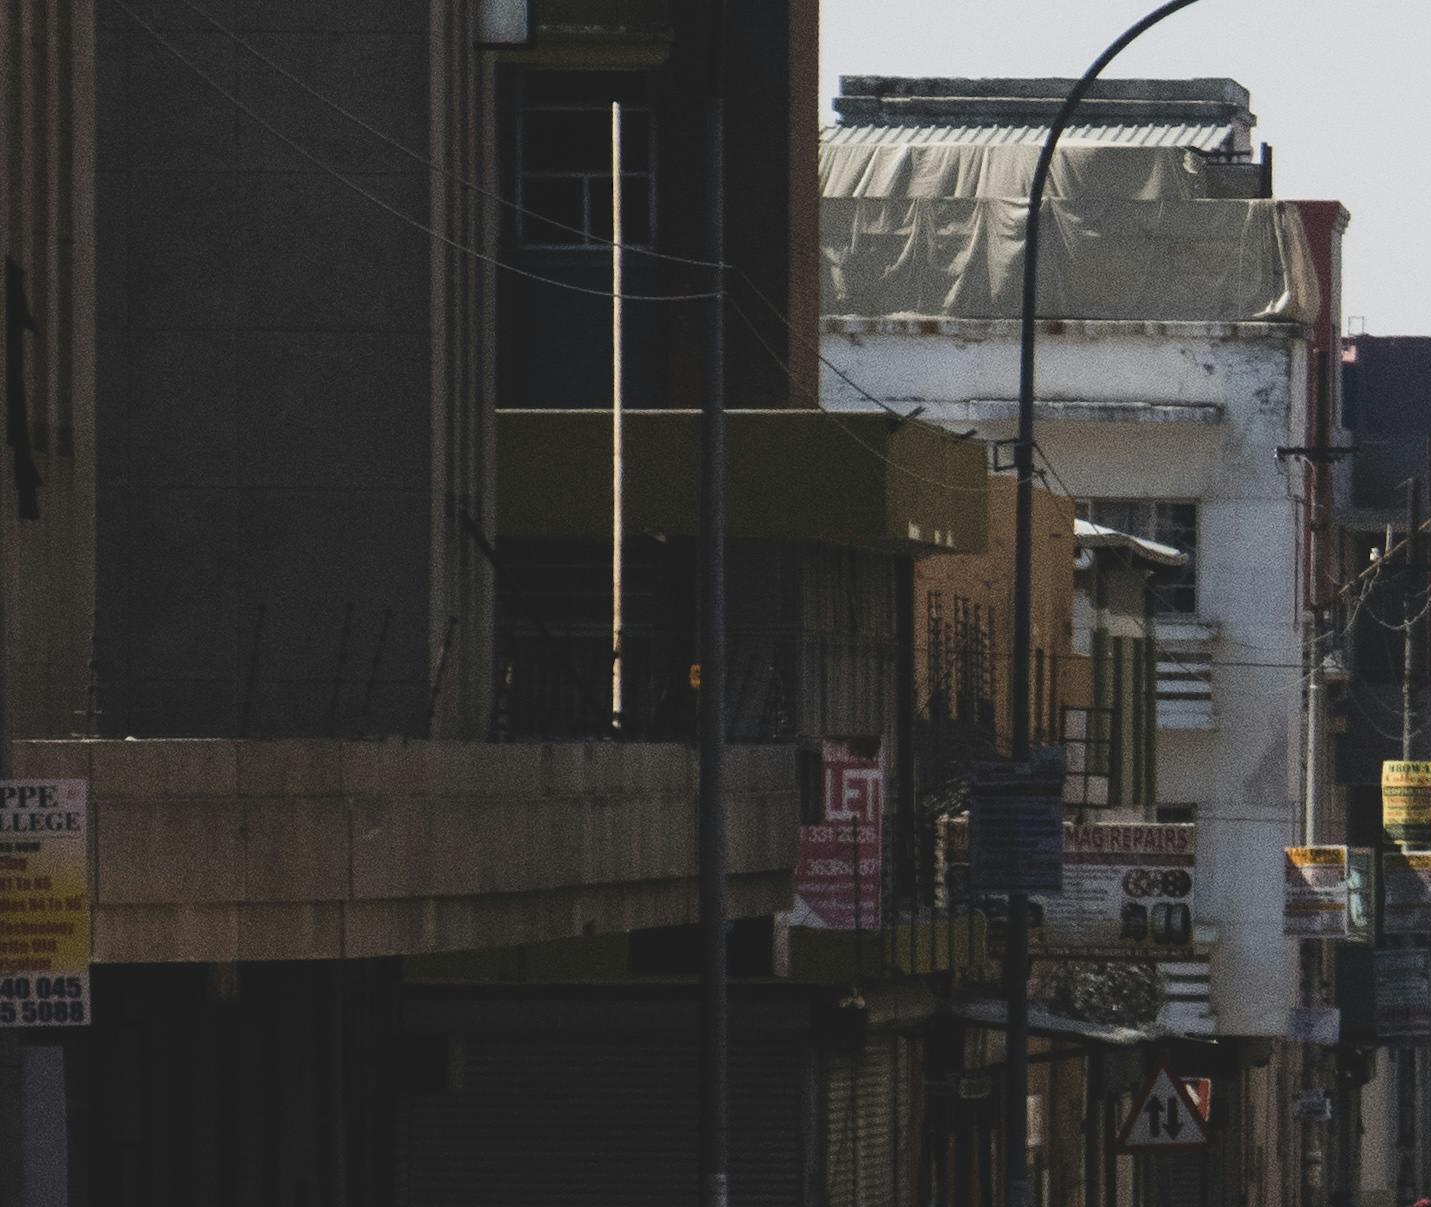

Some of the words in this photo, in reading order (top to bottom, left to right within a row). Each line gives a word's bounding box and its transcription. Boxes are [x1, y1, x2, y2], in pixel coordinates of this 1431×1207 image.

[825, 769, 882, 821] LET
[1110, 827, 1189, 850] REPAIRS
[36, 977, 82, 999] 045
